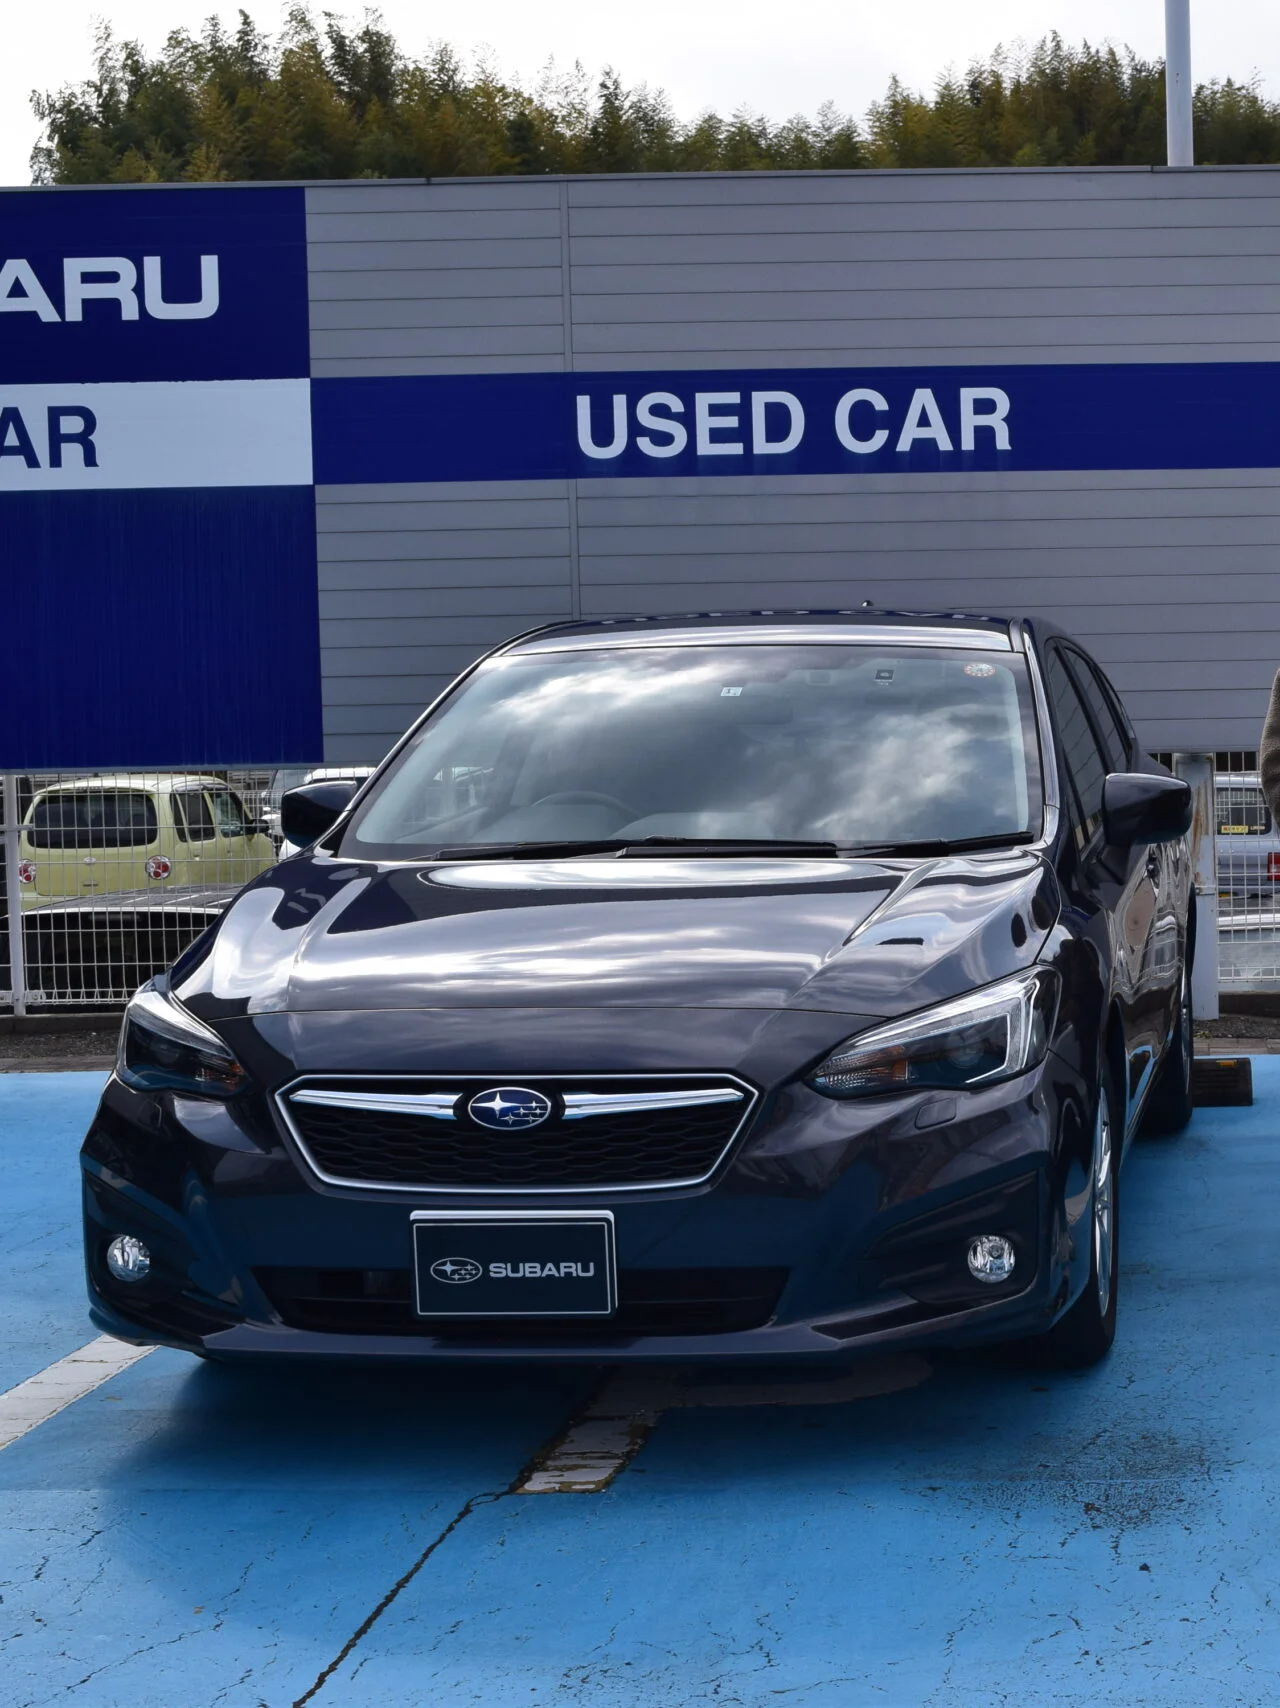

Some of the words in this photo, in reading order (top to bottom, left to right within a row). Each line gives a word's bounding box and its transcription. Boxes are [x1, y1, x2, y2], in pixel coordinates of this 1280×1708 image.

[0, 254, 220, 323] ARU
[576, 390, 805, 459] USED
[834, 386, 1012, 454] CAR
[488, 1262, 595, 1278] SUBARU
